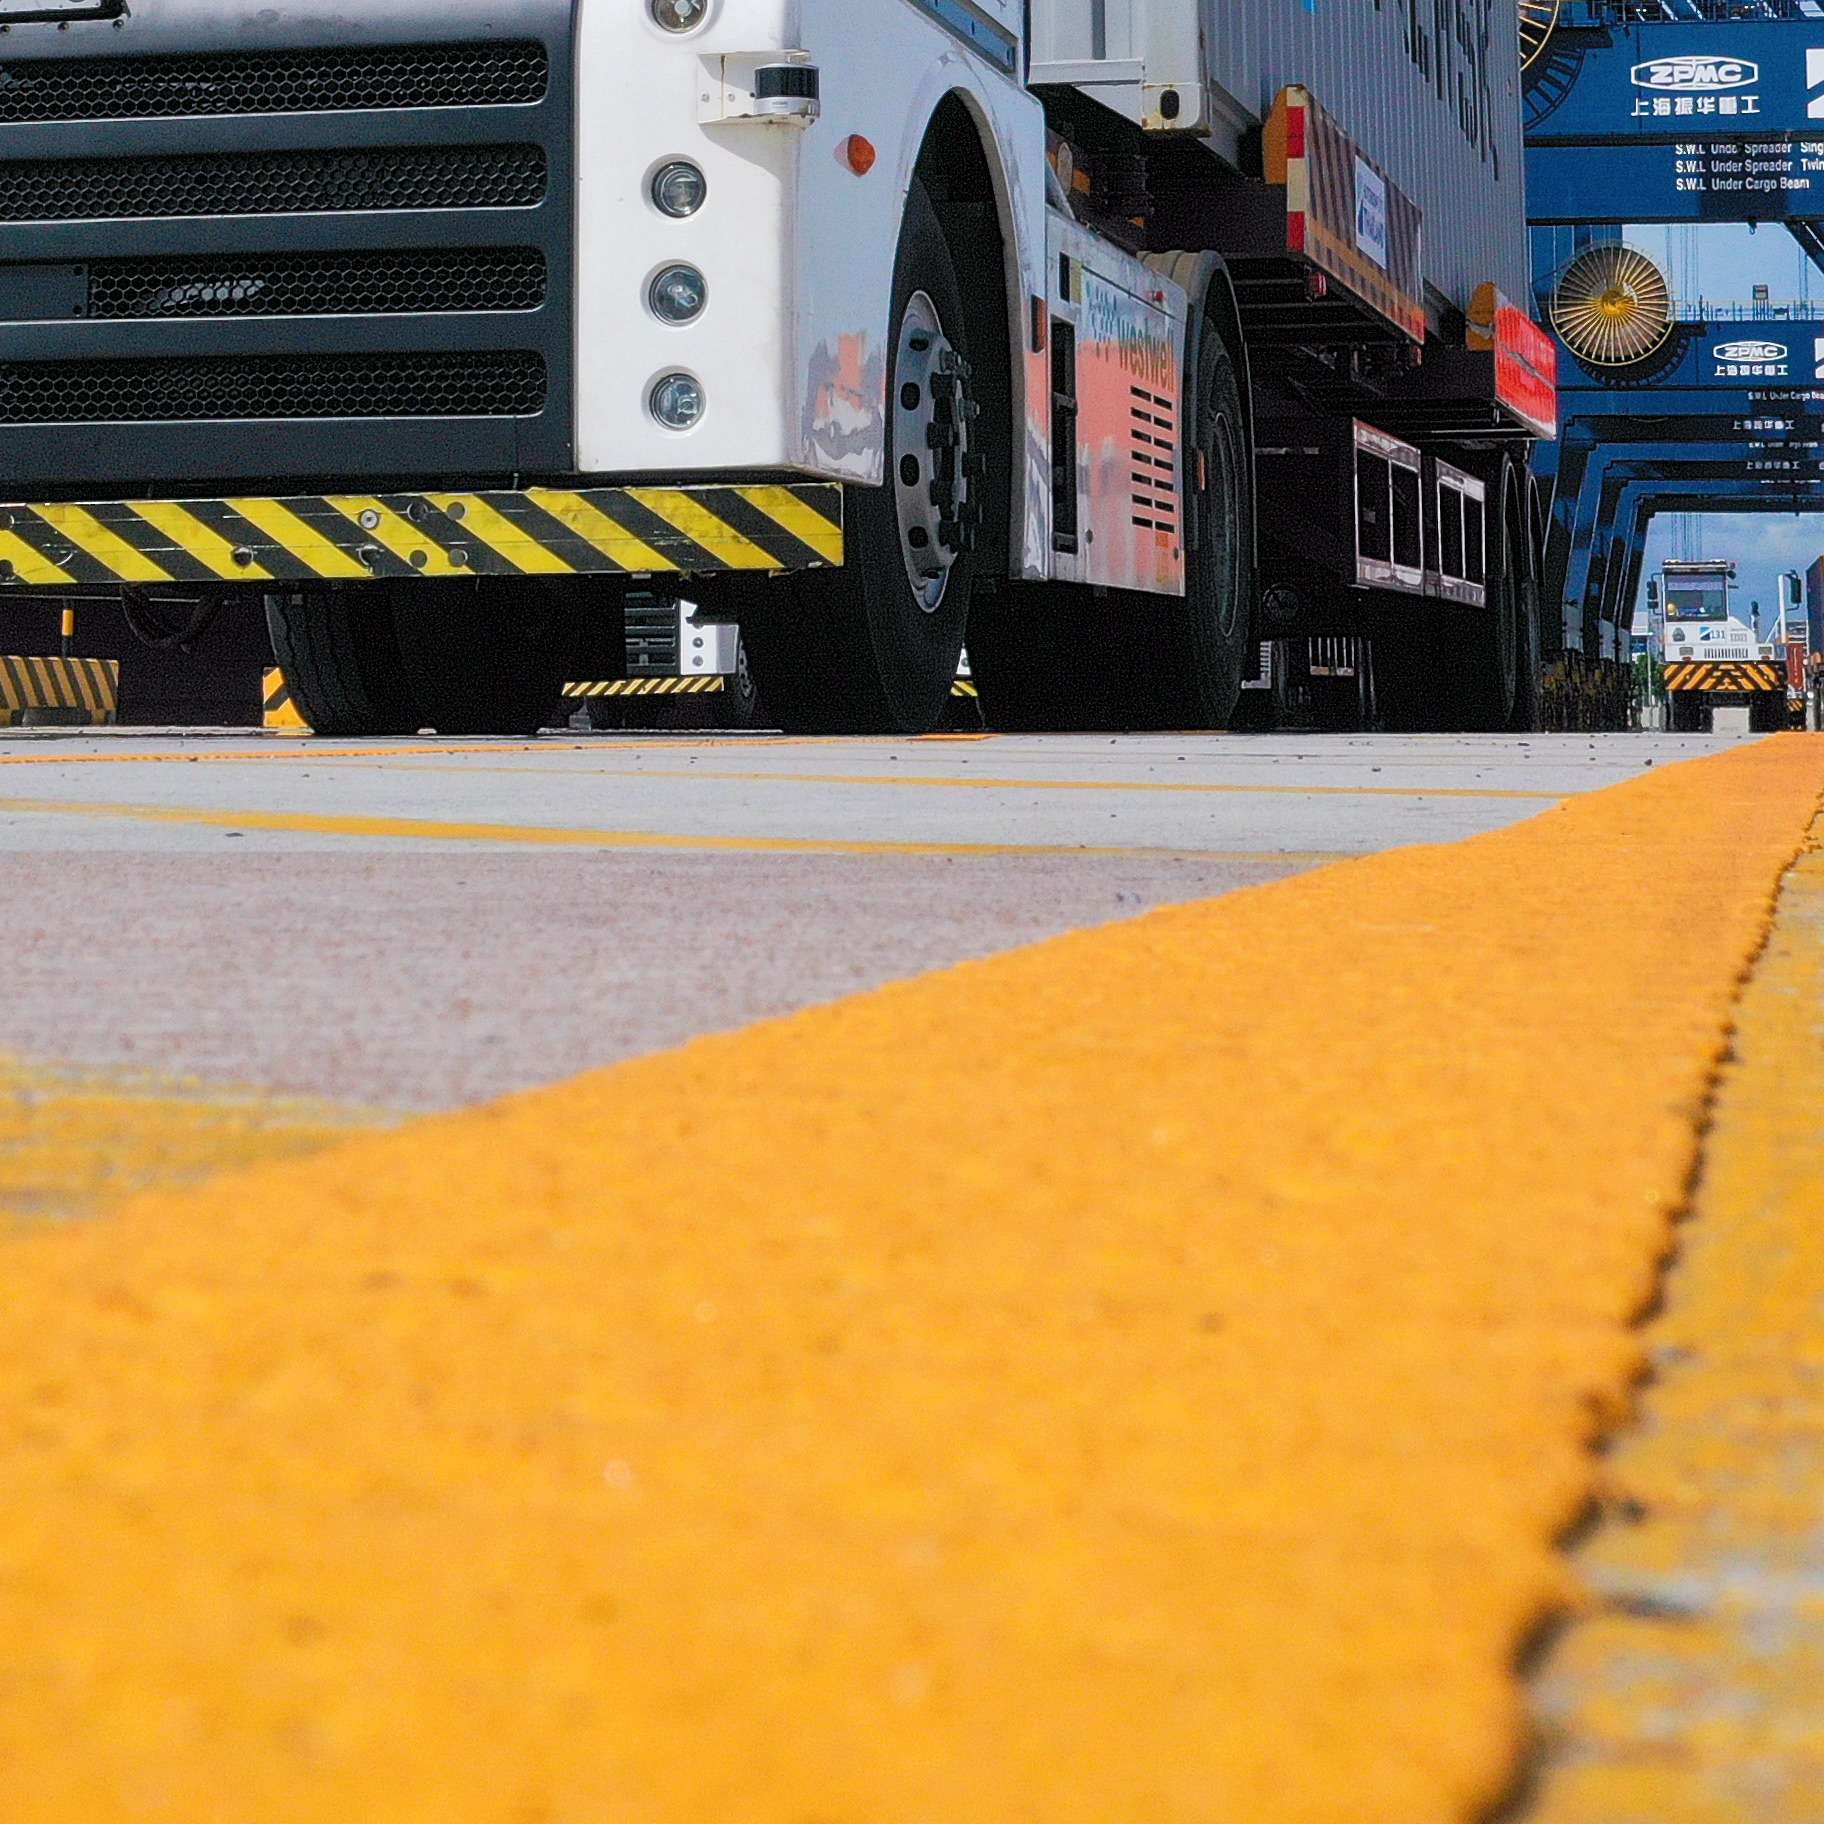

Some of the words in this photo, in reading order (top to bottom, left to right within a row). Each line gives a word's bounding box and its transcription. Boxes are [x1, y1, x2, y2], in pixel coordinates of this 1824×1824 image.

[1649, 63, 1743, 84] ZPMC
[1711, 160, 1743, 173] Under
[1744, 159, 1793, 175] Spreader
[1711, 177, 1743, 191] Under
[1745, 177, 1778, 193] Cargo
[1780, 176, 1810, 190] Beam
